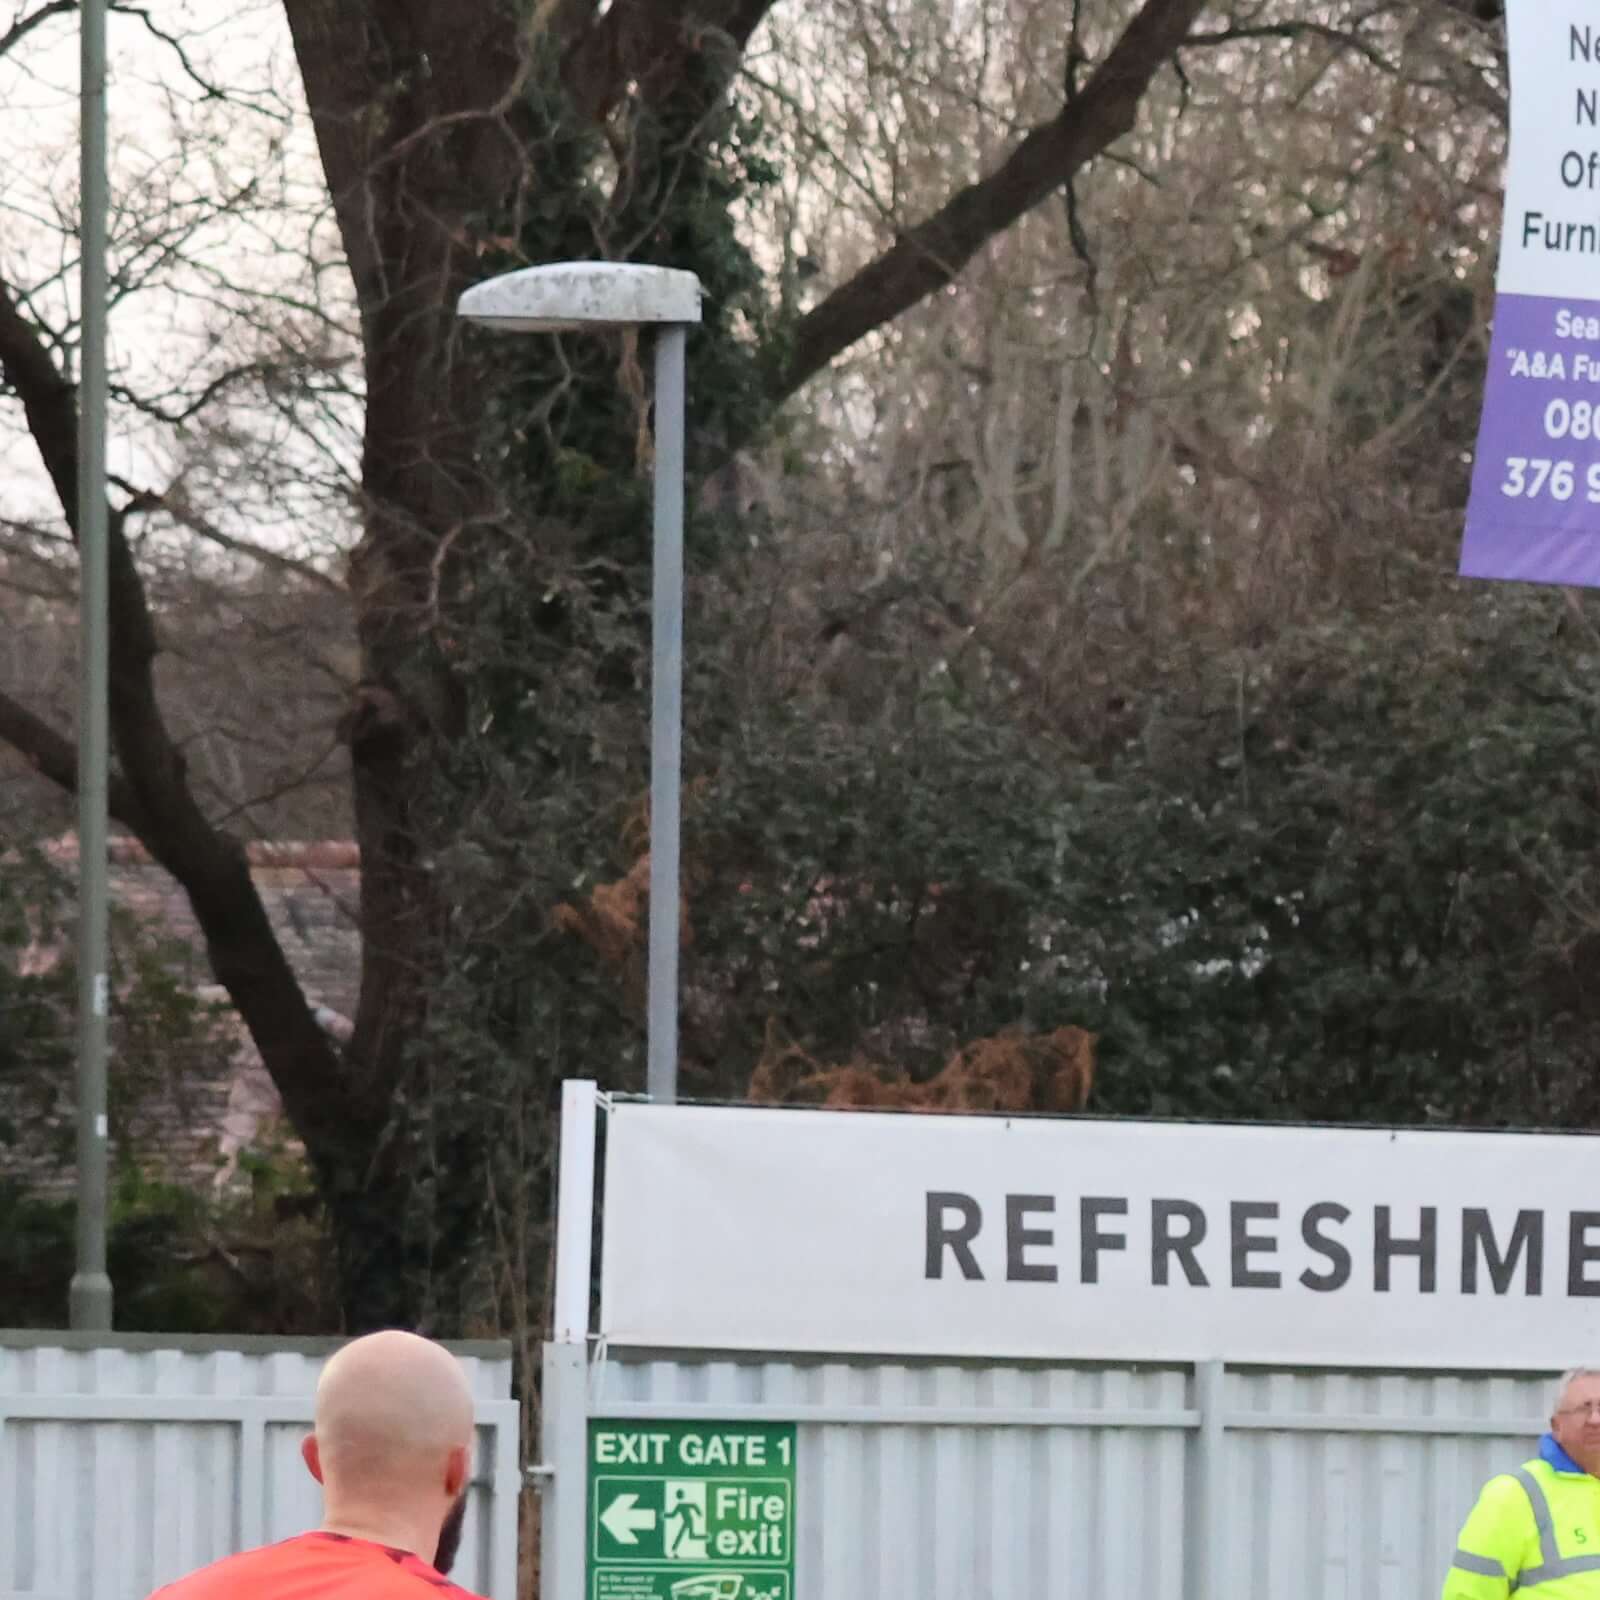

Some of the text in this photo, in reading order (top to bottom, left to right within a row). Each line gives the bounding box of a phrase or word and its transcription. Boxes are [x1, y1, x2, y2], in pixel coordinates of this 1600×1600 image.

[1501, 457, 1574, 501] 376
[595, 1433, 791, 1466] EXIT GATE 1
[716, 1487, 785, 1521] Fire
[716, 1523, 783, 1556] exit
